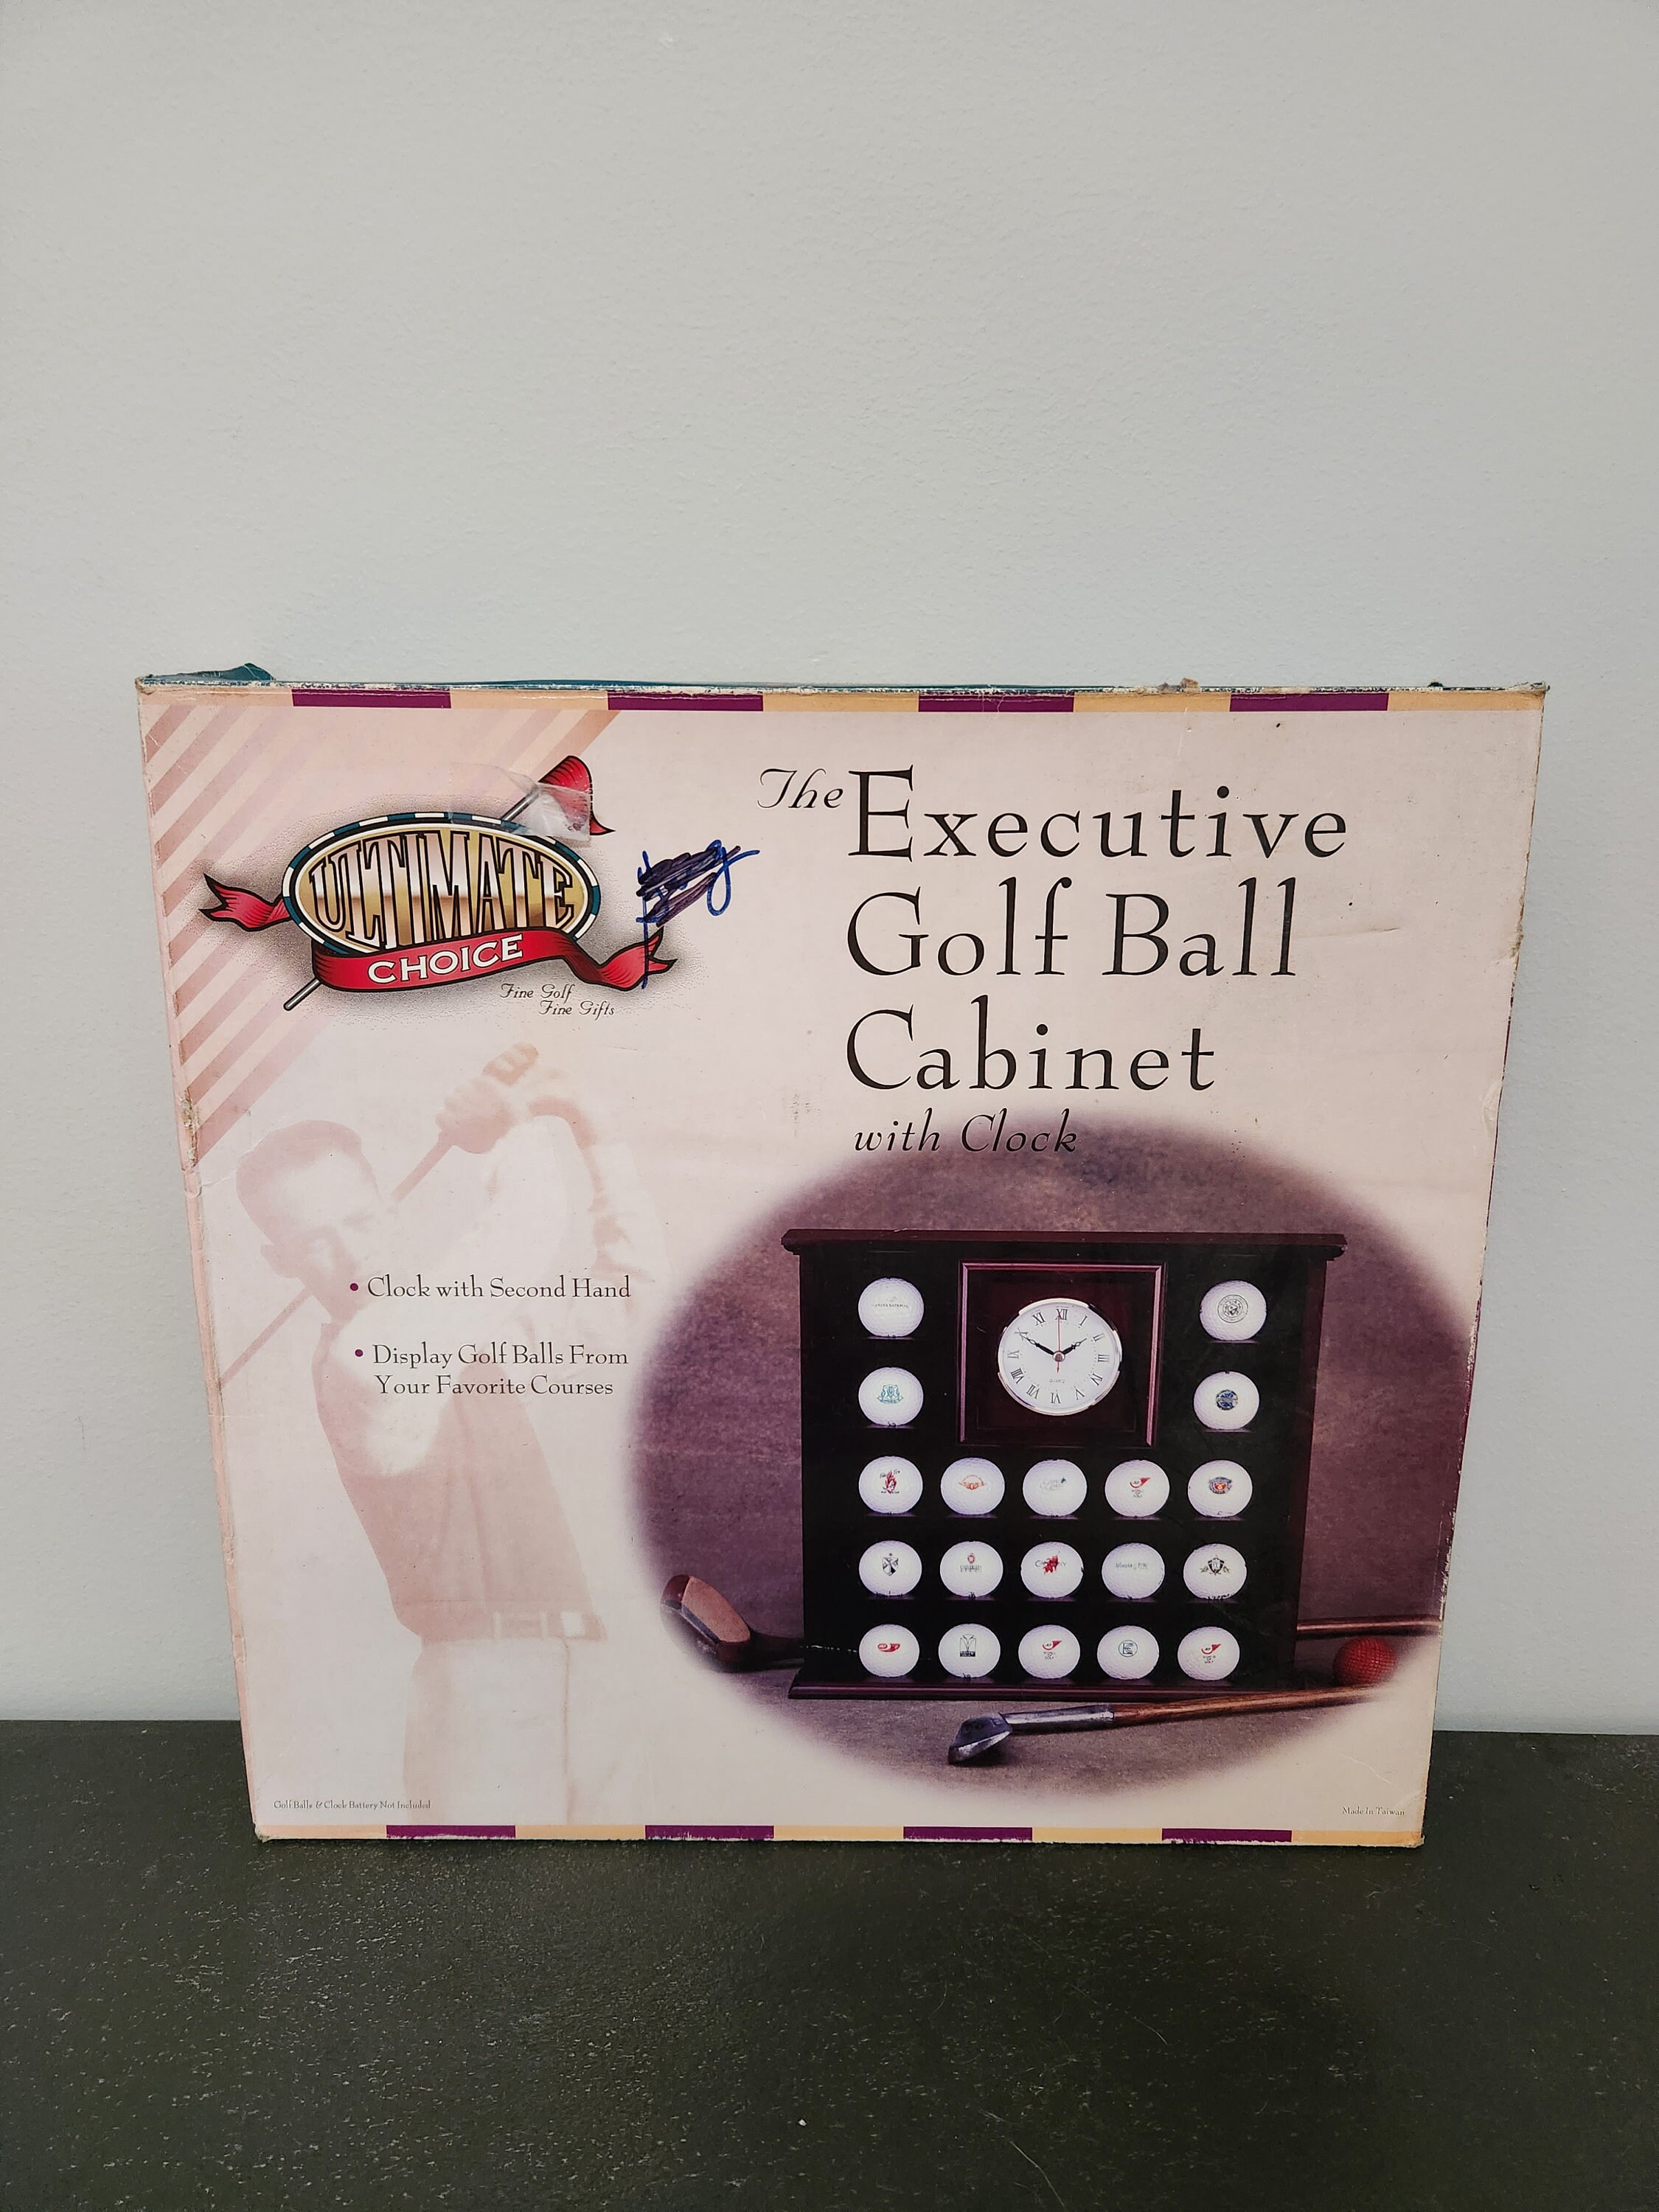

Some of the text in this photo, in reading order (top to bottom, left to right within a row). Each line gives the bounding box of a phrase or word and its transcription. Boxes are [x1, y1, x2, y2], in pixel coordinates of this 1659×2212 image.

[758, 765, 1346, 863] The Executive
[310, 830, 574, 950] ULTIMATE
[847, 877, 1073, 976] Golf
[1102, 877, 1296, 977] Ball
[368, 933, 524, 984] CHOICE
[500, 983, 576, 1004] Fine Golf
[539, 1000, 615, 1021] Fine Gifts
[846, 995, 1215, 1091] Cabinet
[854, 1108, 1078, 1152] with Clock
[367, 1274, 631, 1298] Clock with Second Hand
[372, 1341, 629, 1368] Display Golf Balls From
[375, 1374, 613, 1394] Your Favorite Courses
[274, 1800, 431, 1811] Golf Balls & Clock Battery Not Included
[1342, 1806, 1363, 1815] Made
[1376, 1807, 1405, 1816] Taiwan
